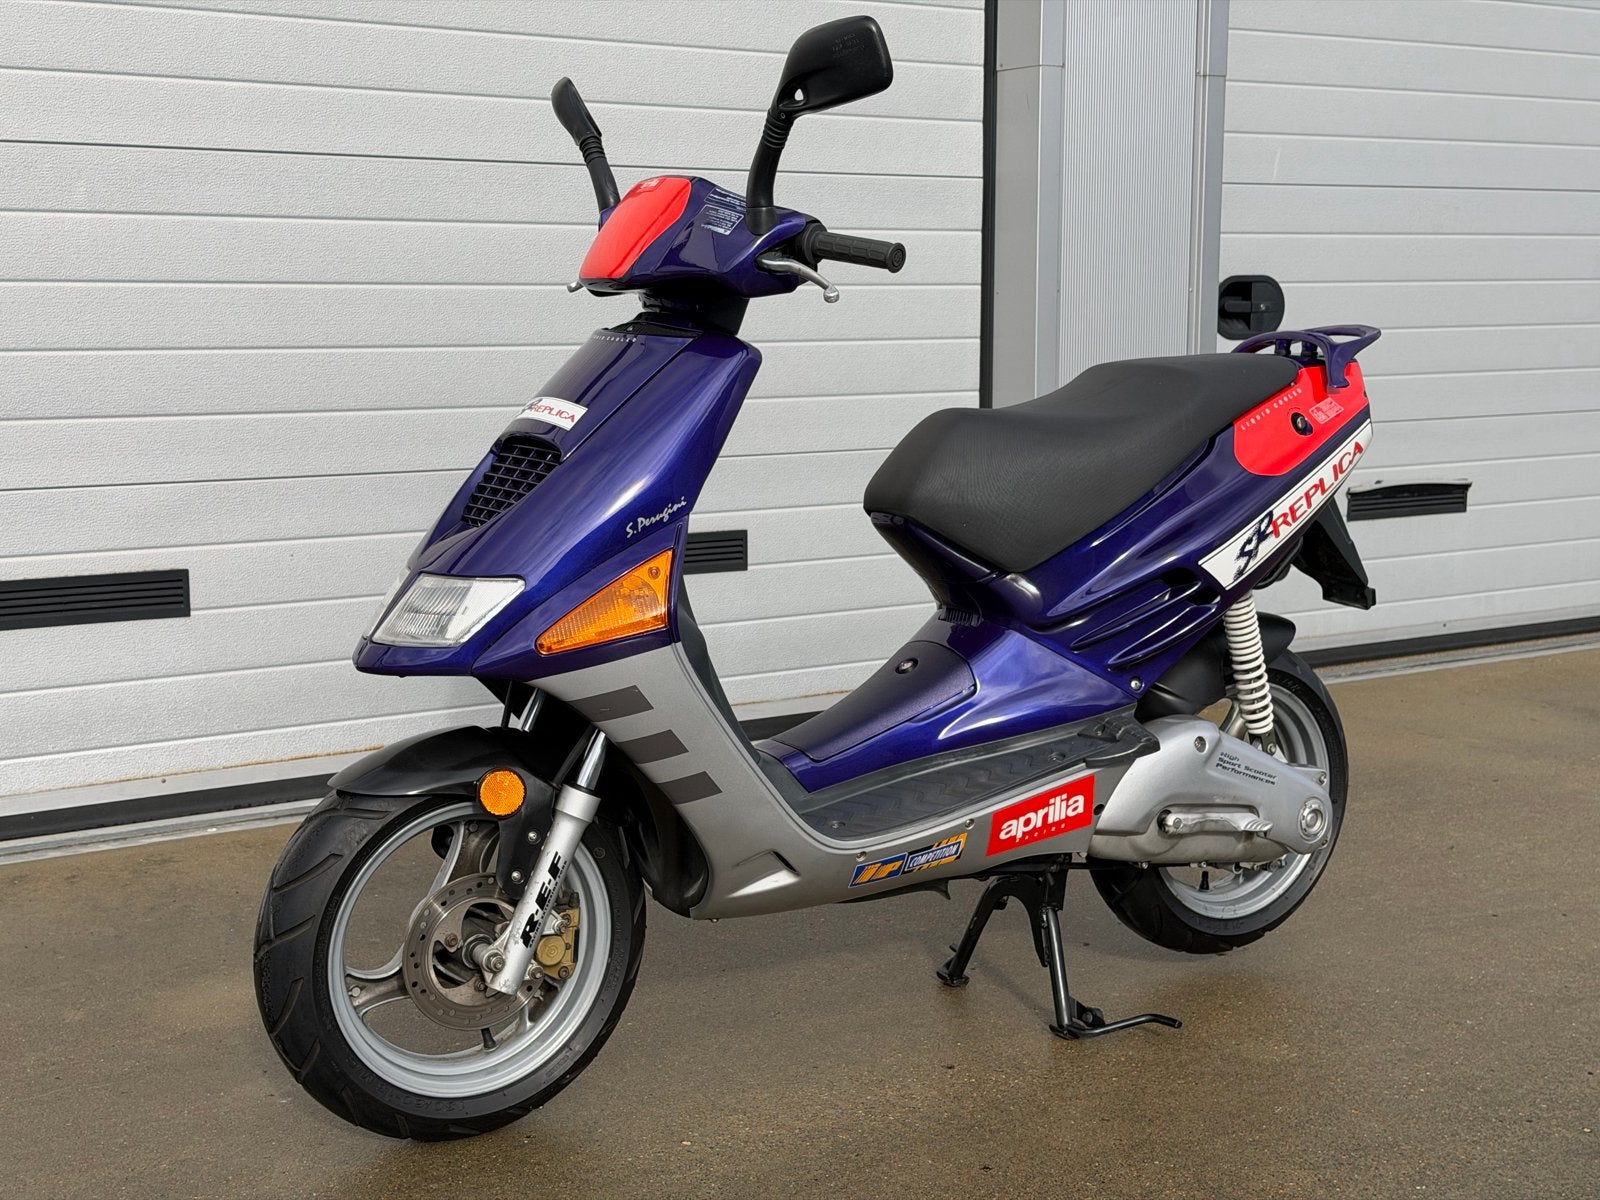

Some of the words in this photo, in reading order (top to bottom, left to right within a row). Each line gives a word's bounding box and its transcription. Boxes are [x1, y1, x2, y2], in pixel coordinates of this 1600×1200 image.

[530, 403, 576, 423] REPLICA
[1241, 407, 1271, 431] LIQUID
[1273, 388, 1303, 409] COOLED
[1271, 441, 1364, 539] REPLICA
[1218, 757, 1241, 769] Sport
[1244, 766, 1277, 779] Scooter
[1220, 752, 1240, 762] High
[1216, 763, 1275, 785] Performances
[998, 793, 1085, 841] aprilia
[909, 843, 960, 868] COMPETITION
